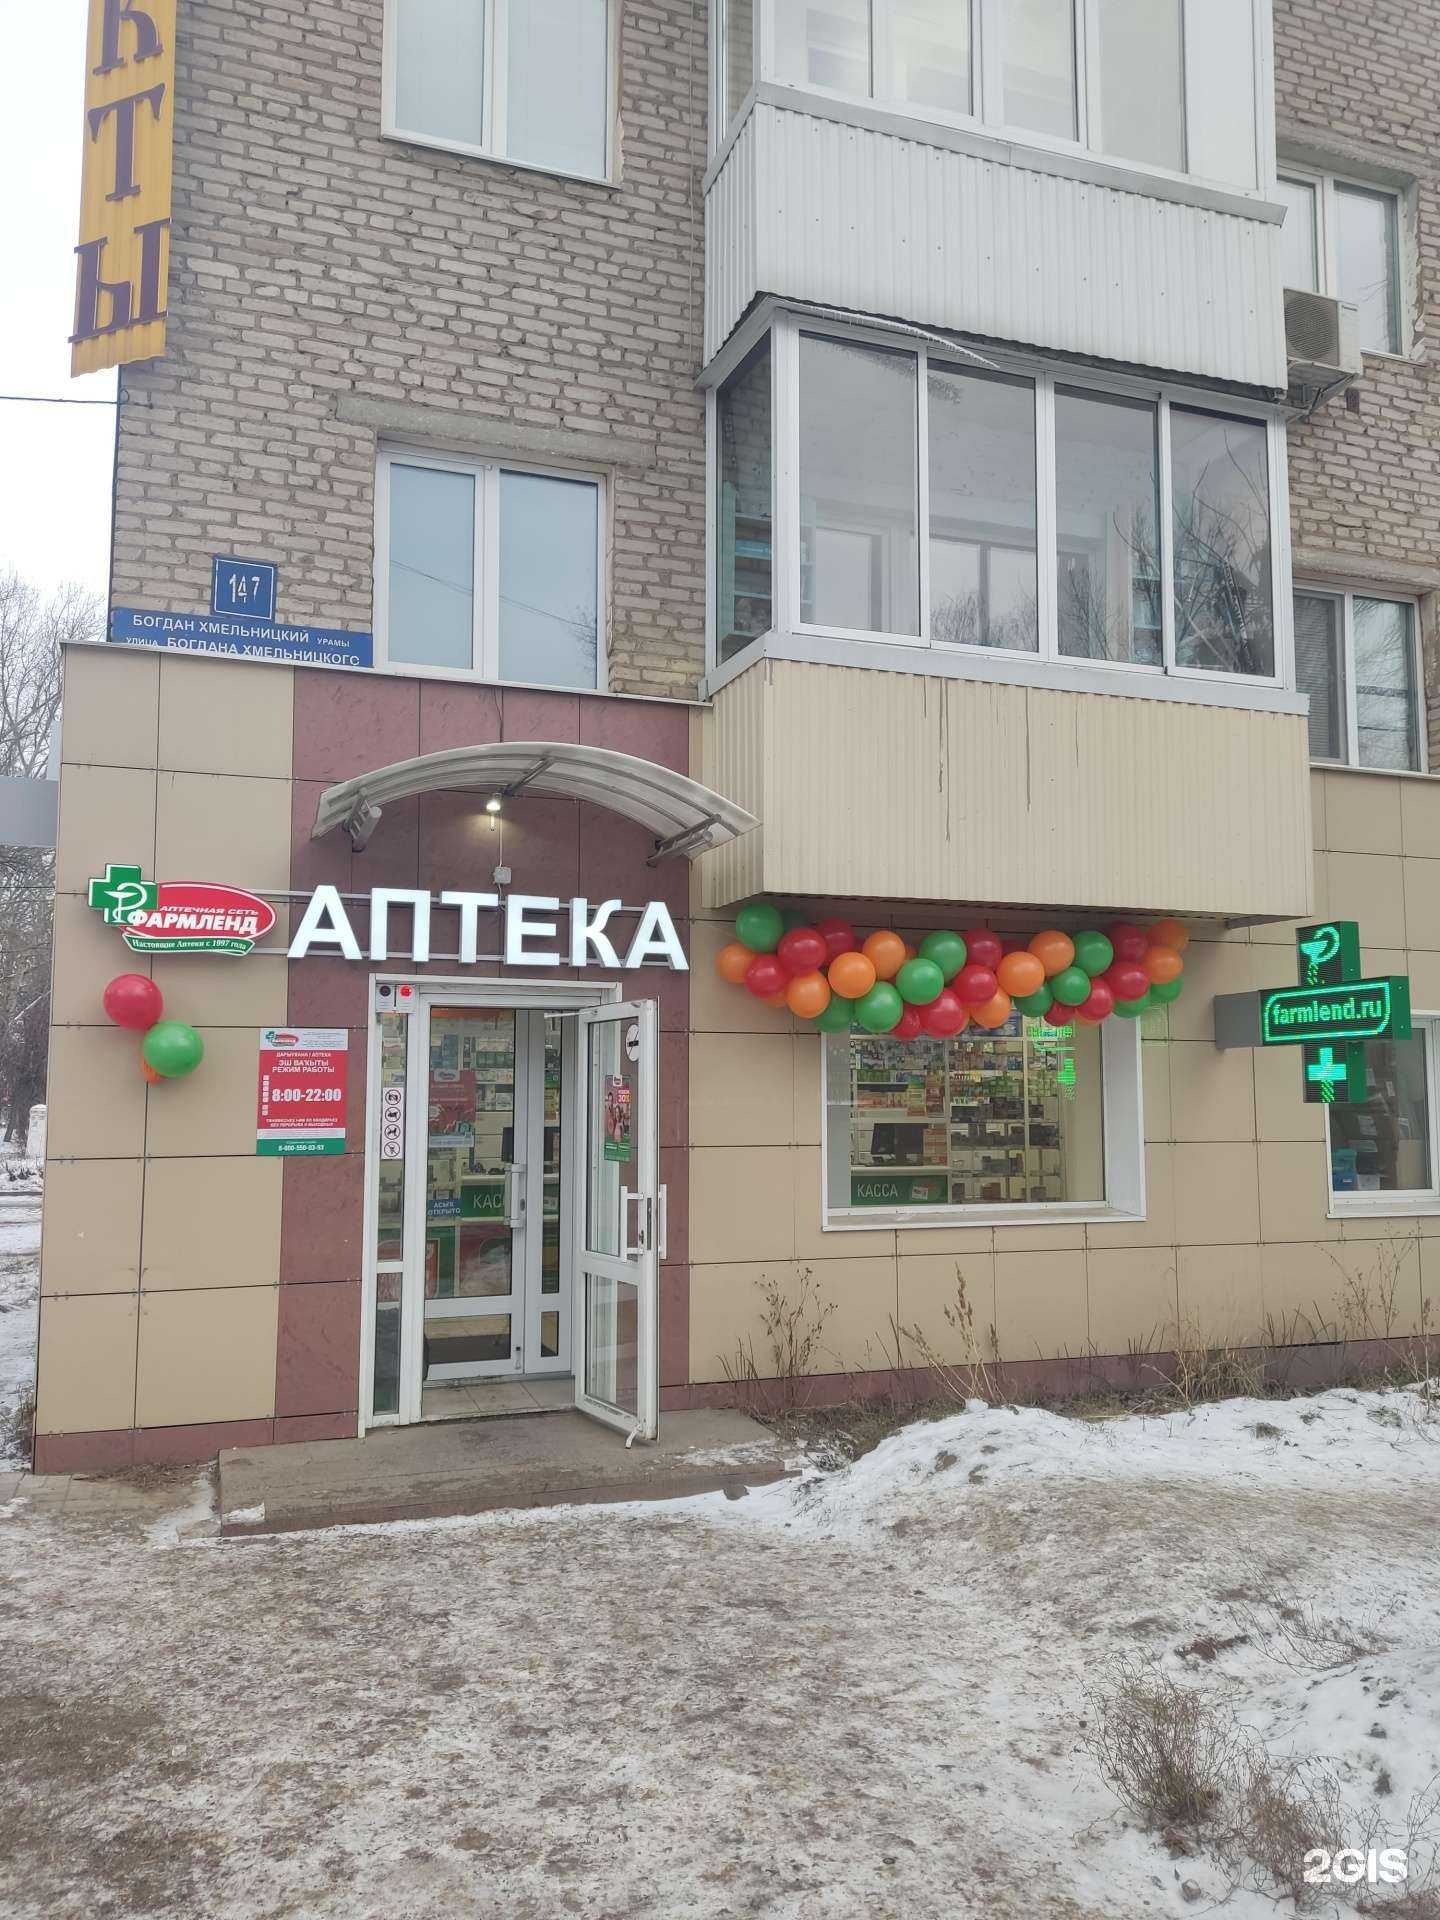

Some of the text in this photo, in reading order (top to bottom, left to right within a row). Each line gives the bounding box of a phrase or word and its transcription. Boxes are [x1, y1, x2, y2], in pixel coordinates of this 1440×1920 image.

[229, 573, 261, 604] 147
[133, 614, 350, 648] БОГДАН ХМЕЛЬНИЦКИЙ УРАМЫ
[126, 637, 360, 666] УЛИЦА БОГДАНА ХМЕЛЬНИЦКОГО
[160, 905, 226, 914] АПТЕЧНАЯ
[127, 910, 258, 934] ФАРМЛЕНД
[287, 884, 689, 970] АПТЕКА
[132, 939, 176, 949] Настоящие
[177, 940, 204, 948] Аптеки
[230, 941, 247, 950] года
[1272, 997, 1382, 1026] farmlend.ru
[272, 1088, 342, 1102] 8:00-22:00
[473, 1194, 505, 1209] КАС
[857, 1183, 898, 1198] КАССА
